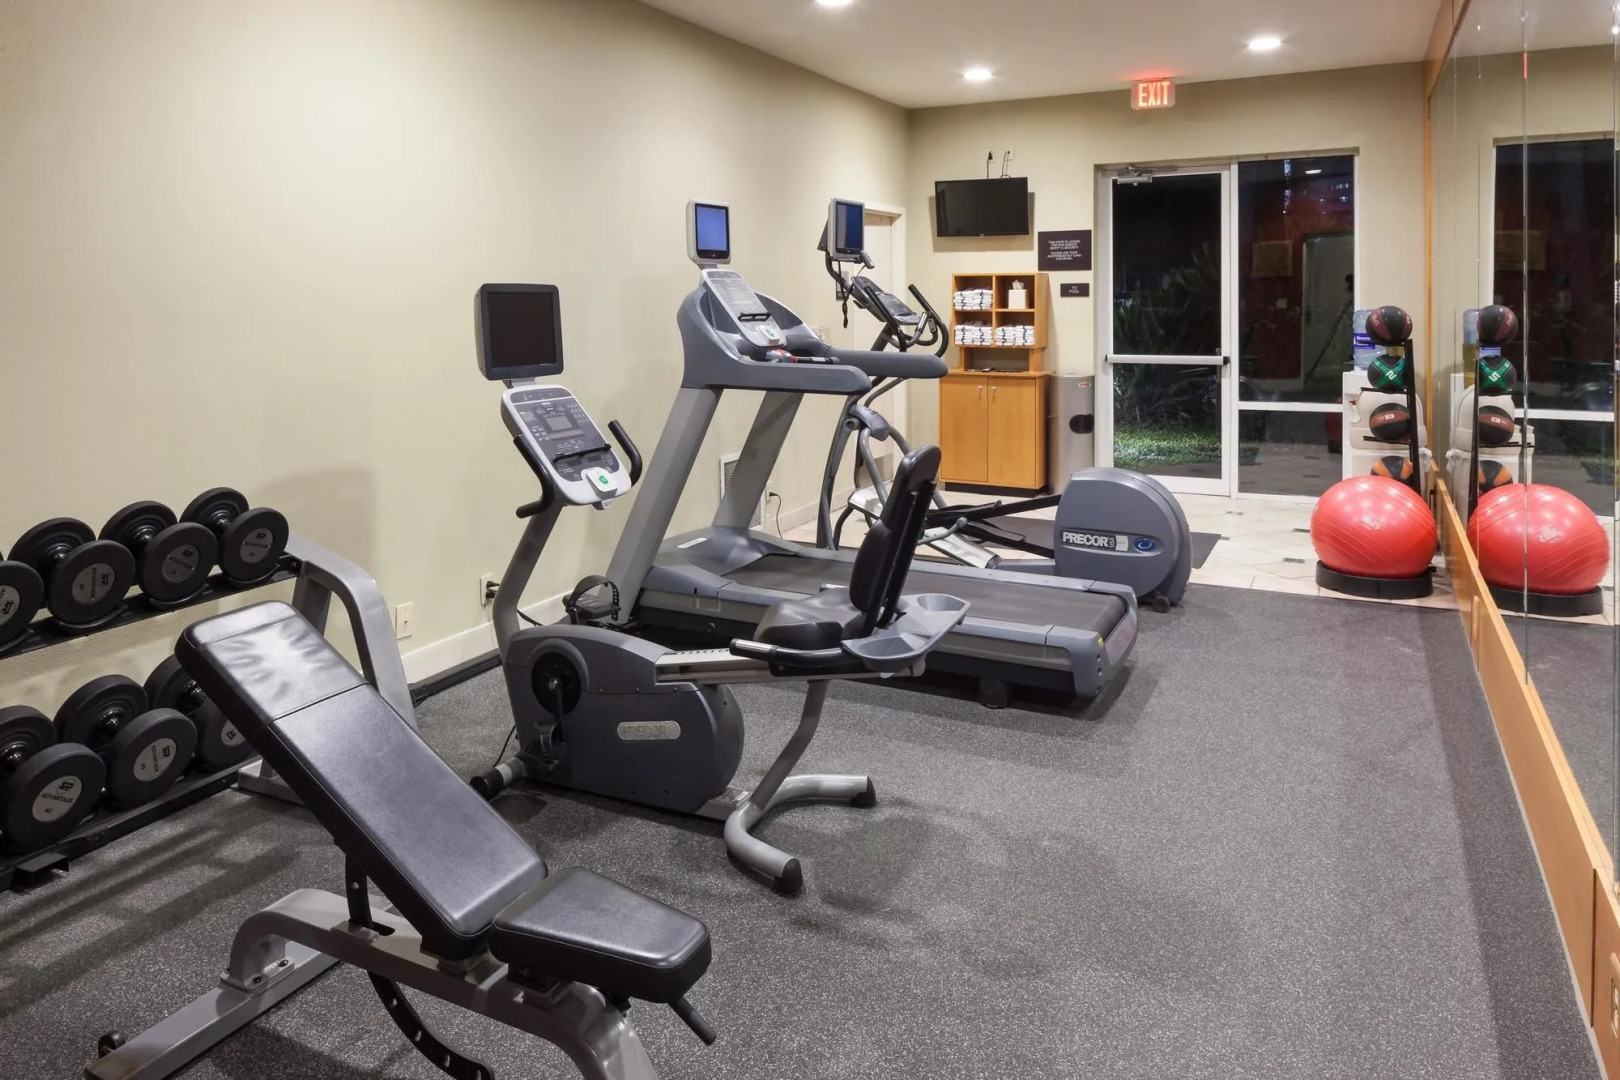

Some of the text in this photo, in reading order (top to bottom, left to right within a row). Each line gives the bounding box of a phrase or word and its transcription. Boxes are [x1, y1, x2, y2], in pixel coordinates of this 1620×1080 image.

[1138, 82, 1170, 107] EXIT
[1062, 531, 1108, 547] PRECOR
[41, 791, 73, 803] ADVANTAGE
